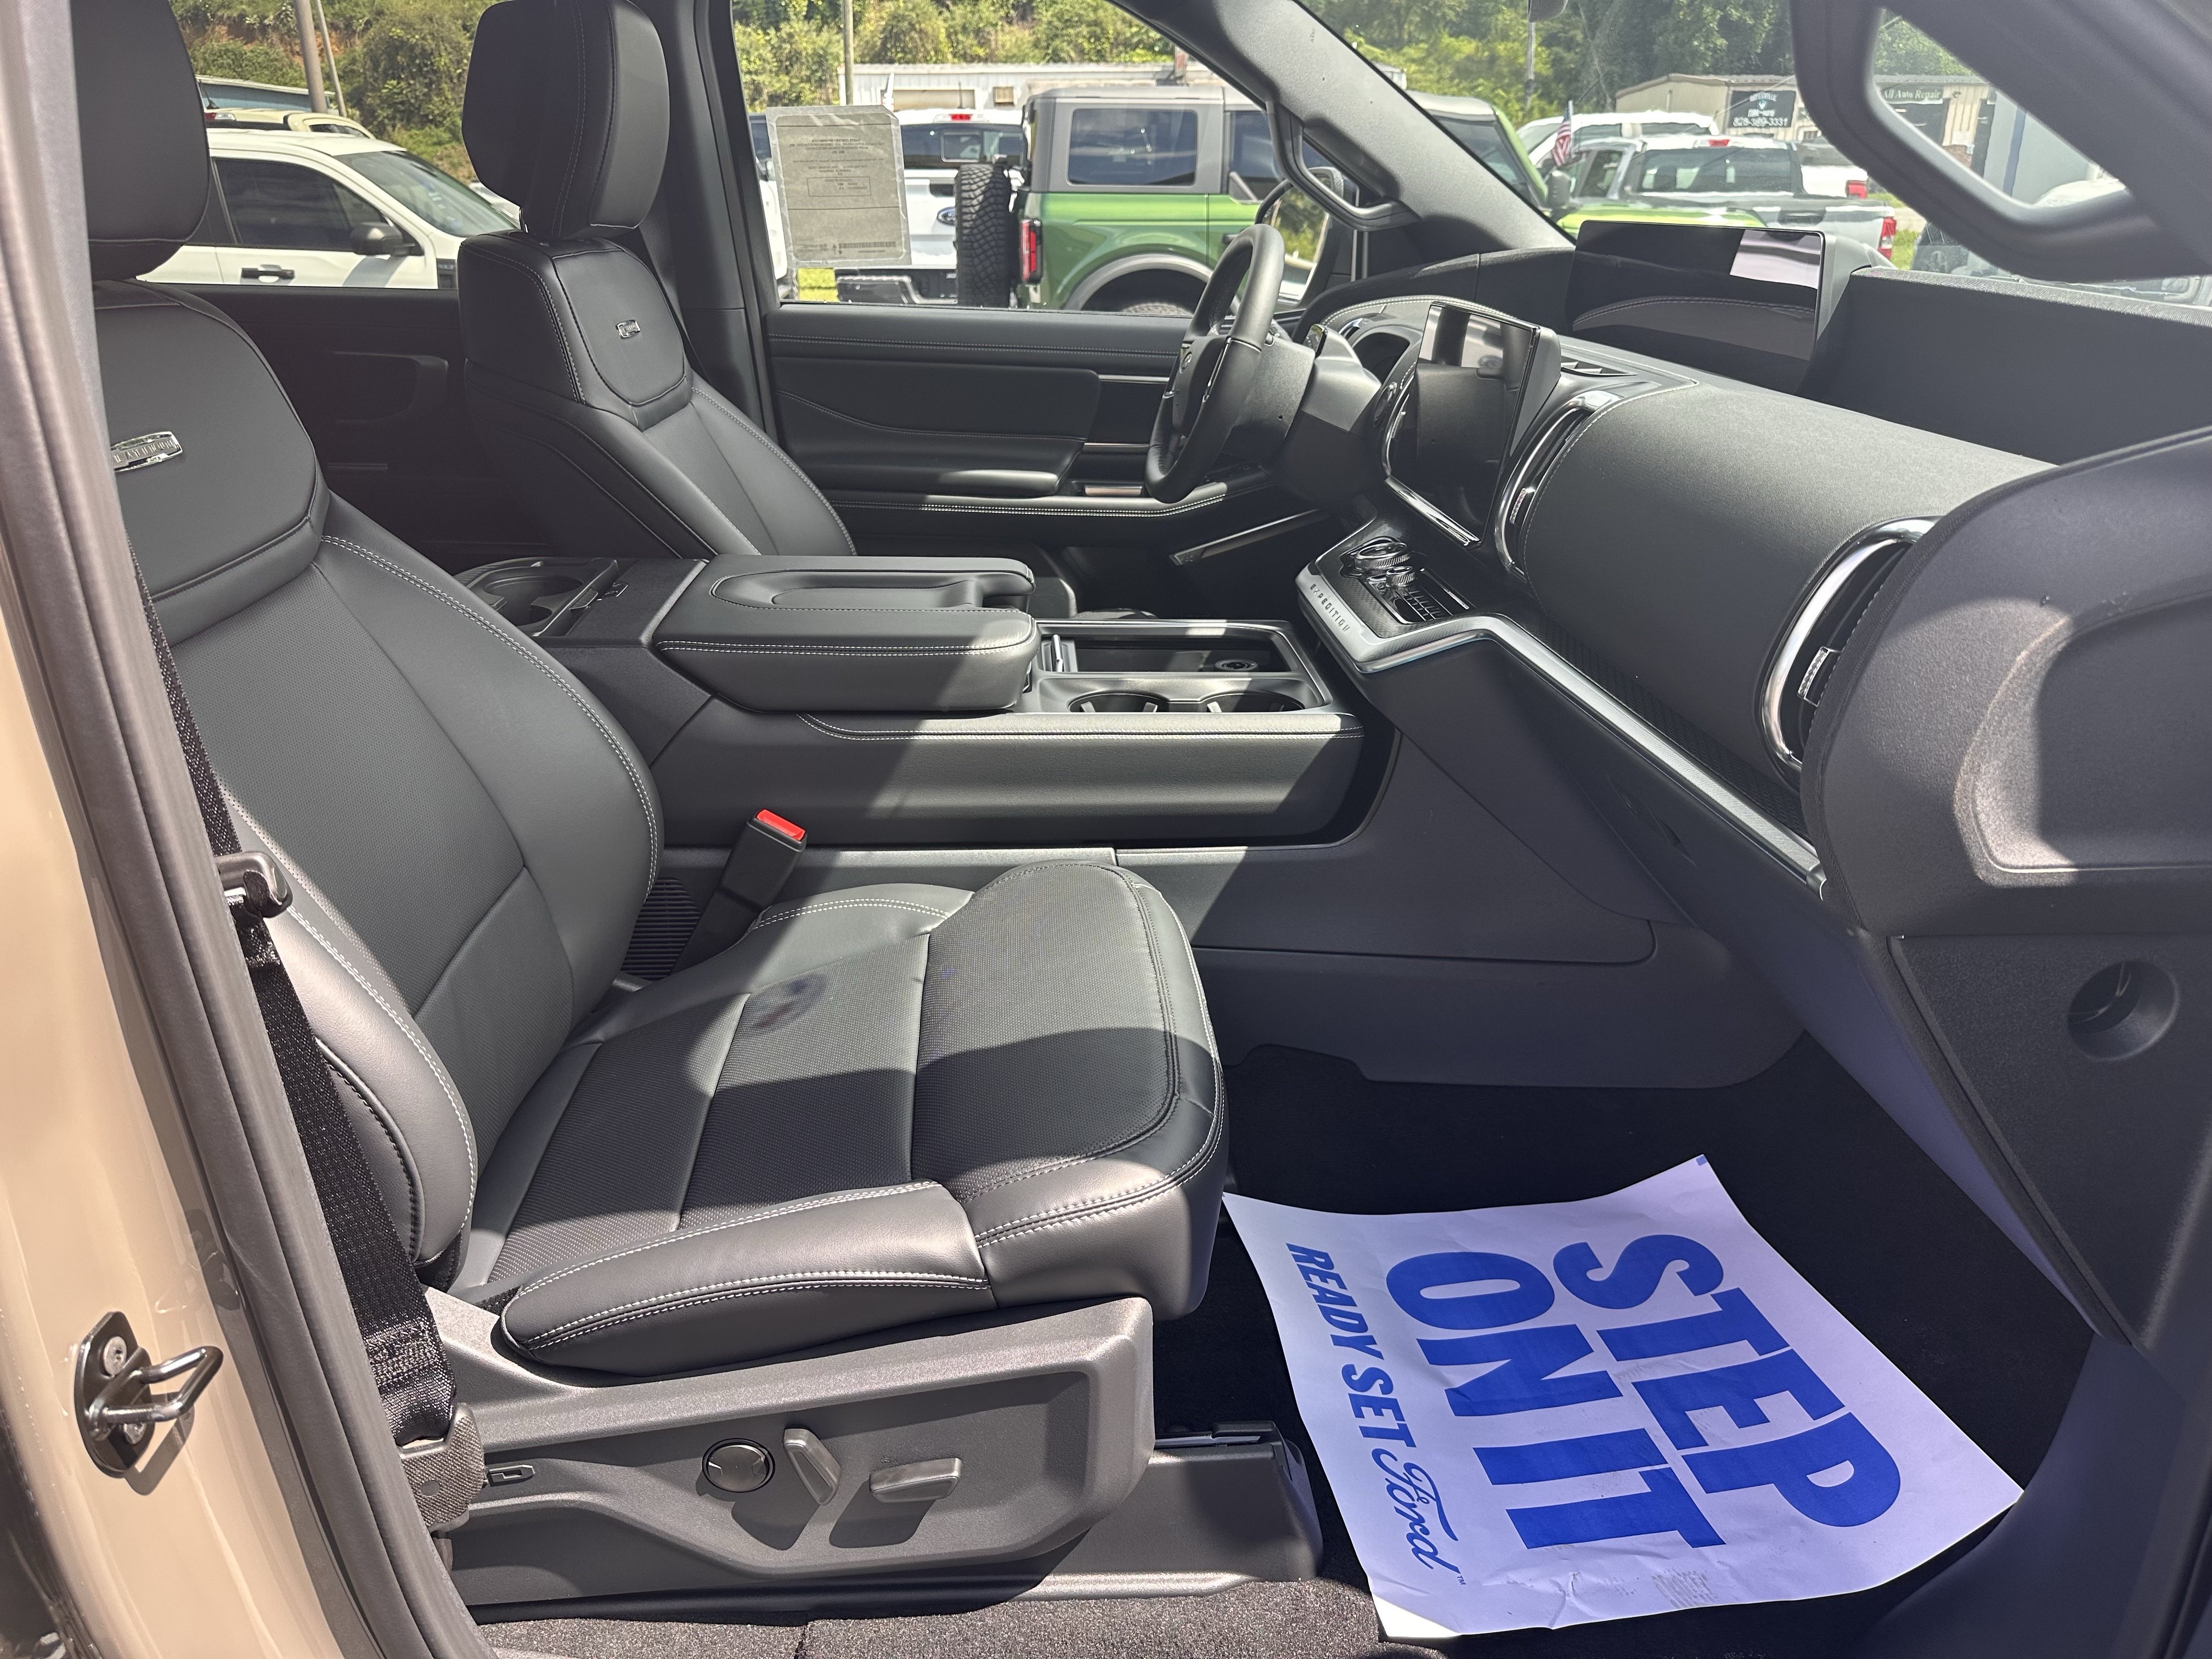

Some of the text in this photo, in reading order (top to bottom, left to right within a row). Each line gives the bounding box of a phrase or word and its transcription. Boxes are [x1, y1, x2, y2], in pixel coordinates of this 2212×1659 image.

[1895, 89, 1913, 99] Auto
[1915, 89, 1940, 99] Repair
[1310, 583, 1351, 633] EXPEDITION
[1286, 1243, 1383, 1359] READY
[1341, 1363, 1417, 1448] SET
[1386, 1251, 1725, 1550] ON IT
[1553, 1234, 1901, 1527] STEP
[1370, 1448, 1460, 1573] Ford
